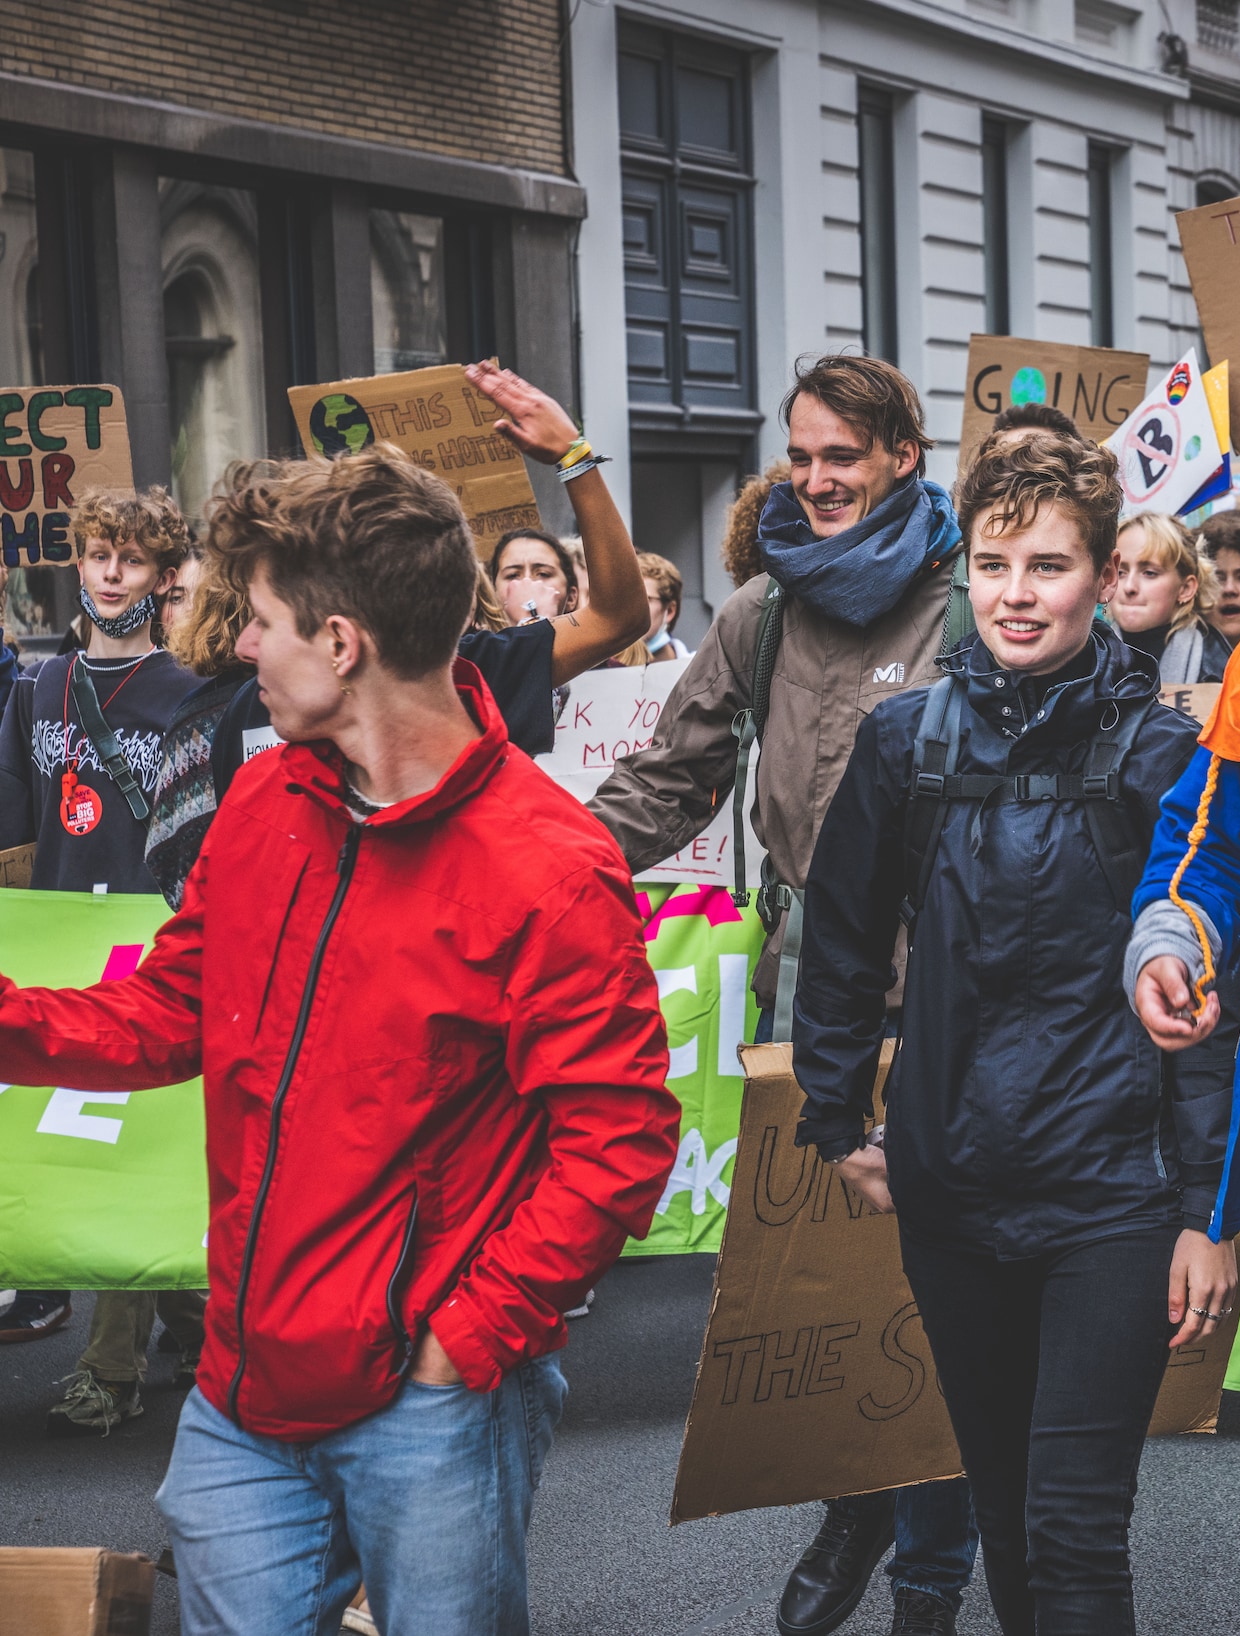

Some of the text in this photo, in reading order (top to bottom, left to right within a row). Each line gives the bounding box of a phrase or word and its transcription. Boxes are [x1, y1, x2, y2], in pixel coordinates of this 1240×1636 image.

[0, 387, 113, 456] ECT
[406, 450, 436, 469] NG
[468, 509, 540, 536] OYFRIEND
[0, 512, 72, 568] HE
[628, 698, 661, 728] YO
[76, 801, 93, 810] STOP
[77, 807, 94, 819] BIG
[754, 1117, 897, 1227] UN
[713, 1301, 946, 1421] THE S
